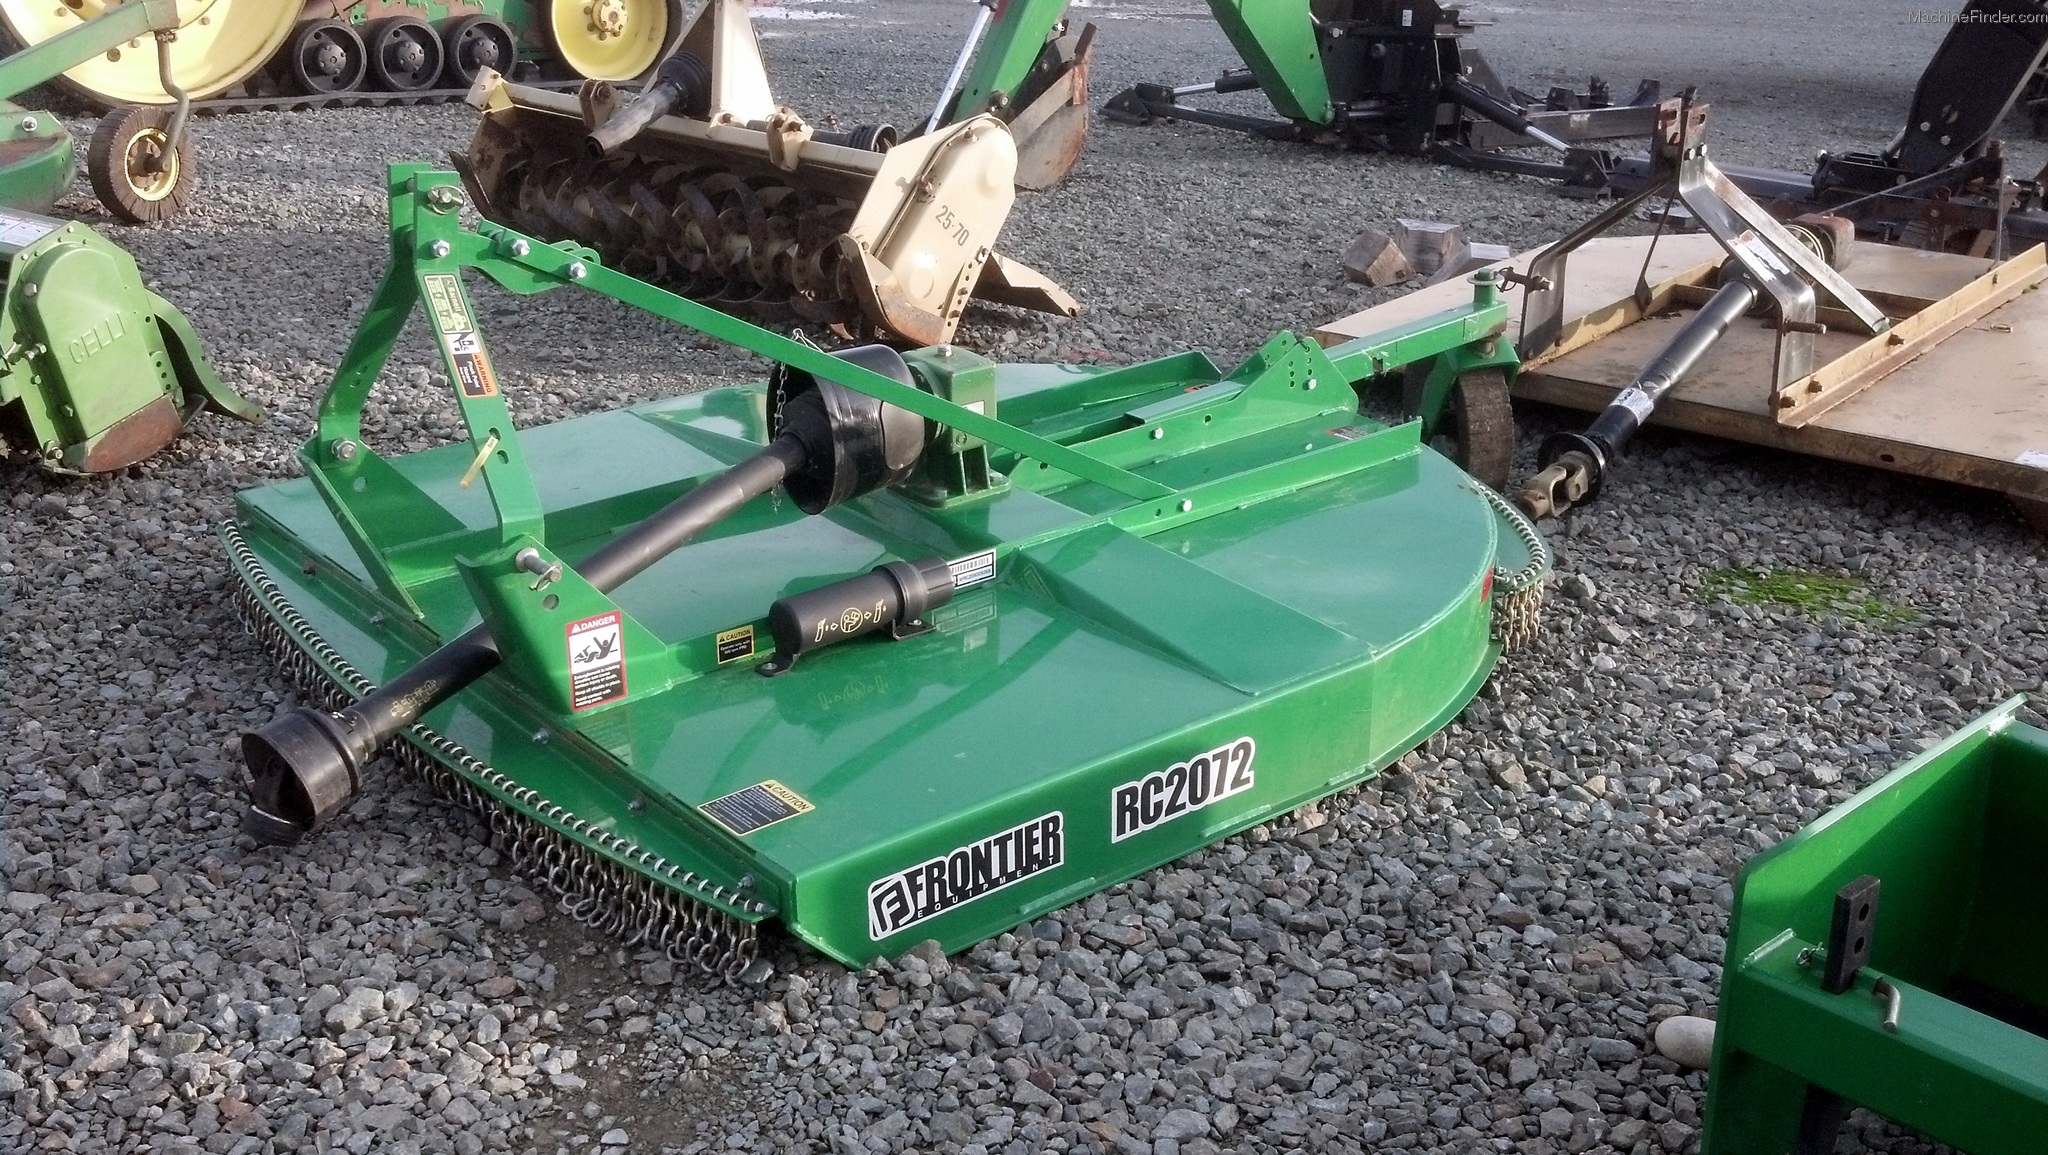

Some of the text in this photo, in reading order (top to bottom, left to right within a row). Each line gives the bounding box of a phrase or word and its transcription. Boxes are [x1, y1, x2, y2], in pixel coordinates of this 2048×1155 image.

[68, 311, 127, 365] CELLI
[475, 359, 492, 393] WARNING
[581, 615, 616, 631] DANGER
[726, 629, 750, 640] CAUTION
[772, 786, 810, 810] CAUTION
[1116, 742, 1251, 836] RC2072
[903, 814, 1061, 908] FRONTIER
[917, 856, 1055, 918] EQUIPMENT
